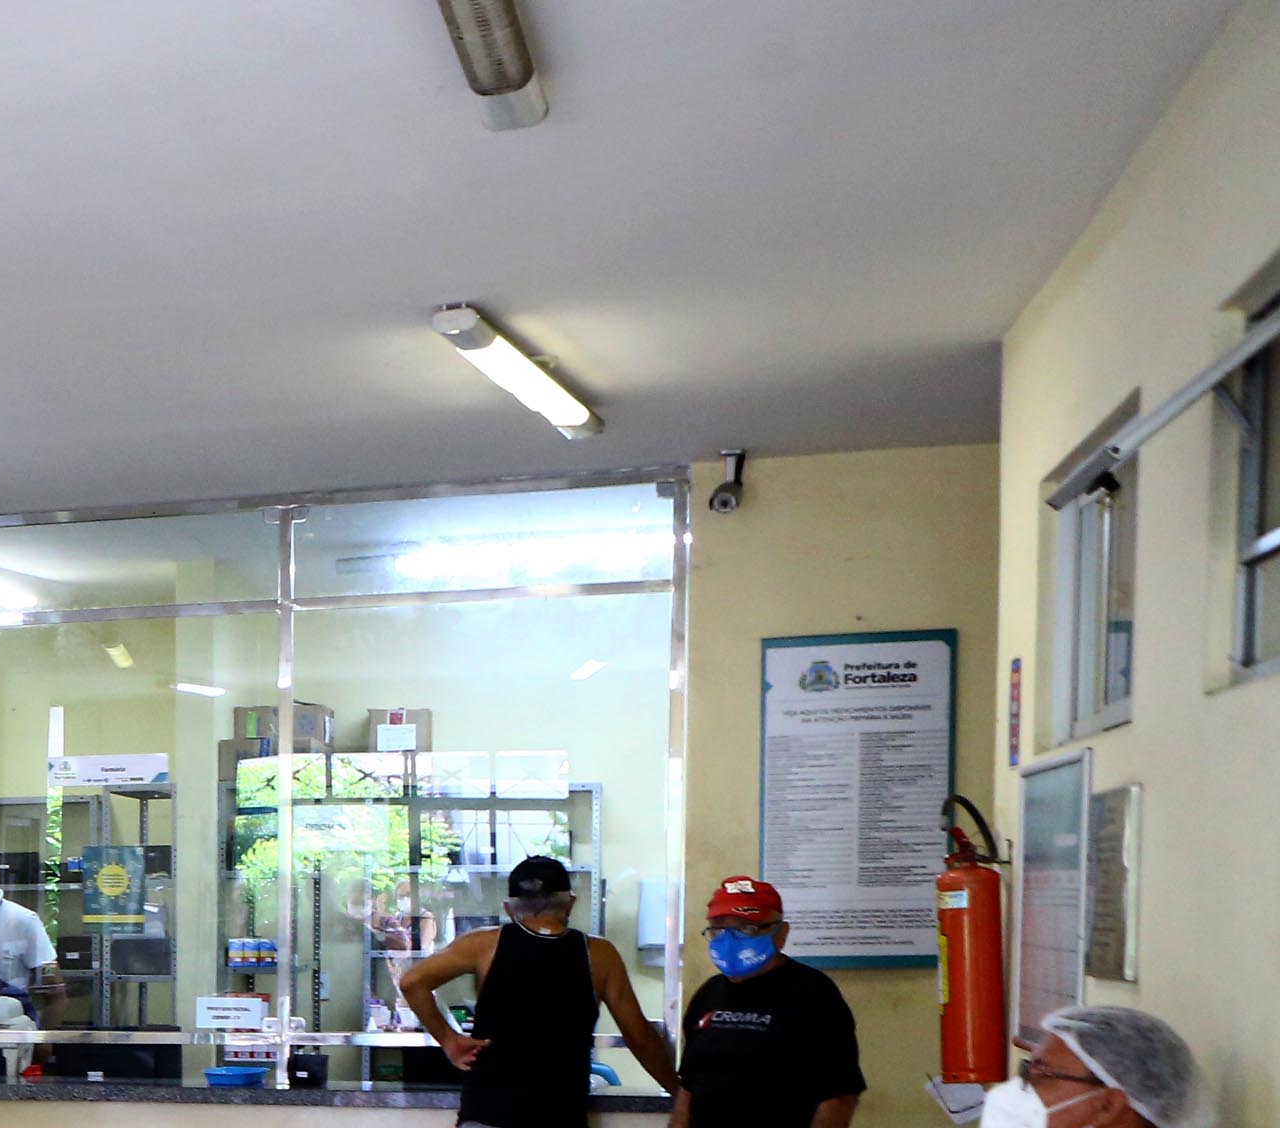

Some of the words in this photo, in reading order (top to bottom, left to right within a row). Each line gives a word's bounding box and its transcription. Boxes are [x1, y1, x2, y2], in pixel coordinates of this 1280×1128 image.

[844, 662, 900, 671] Prefeitura
[903, 661, 918, 669] de
[844, 671, 917, 685] Fortaleza
